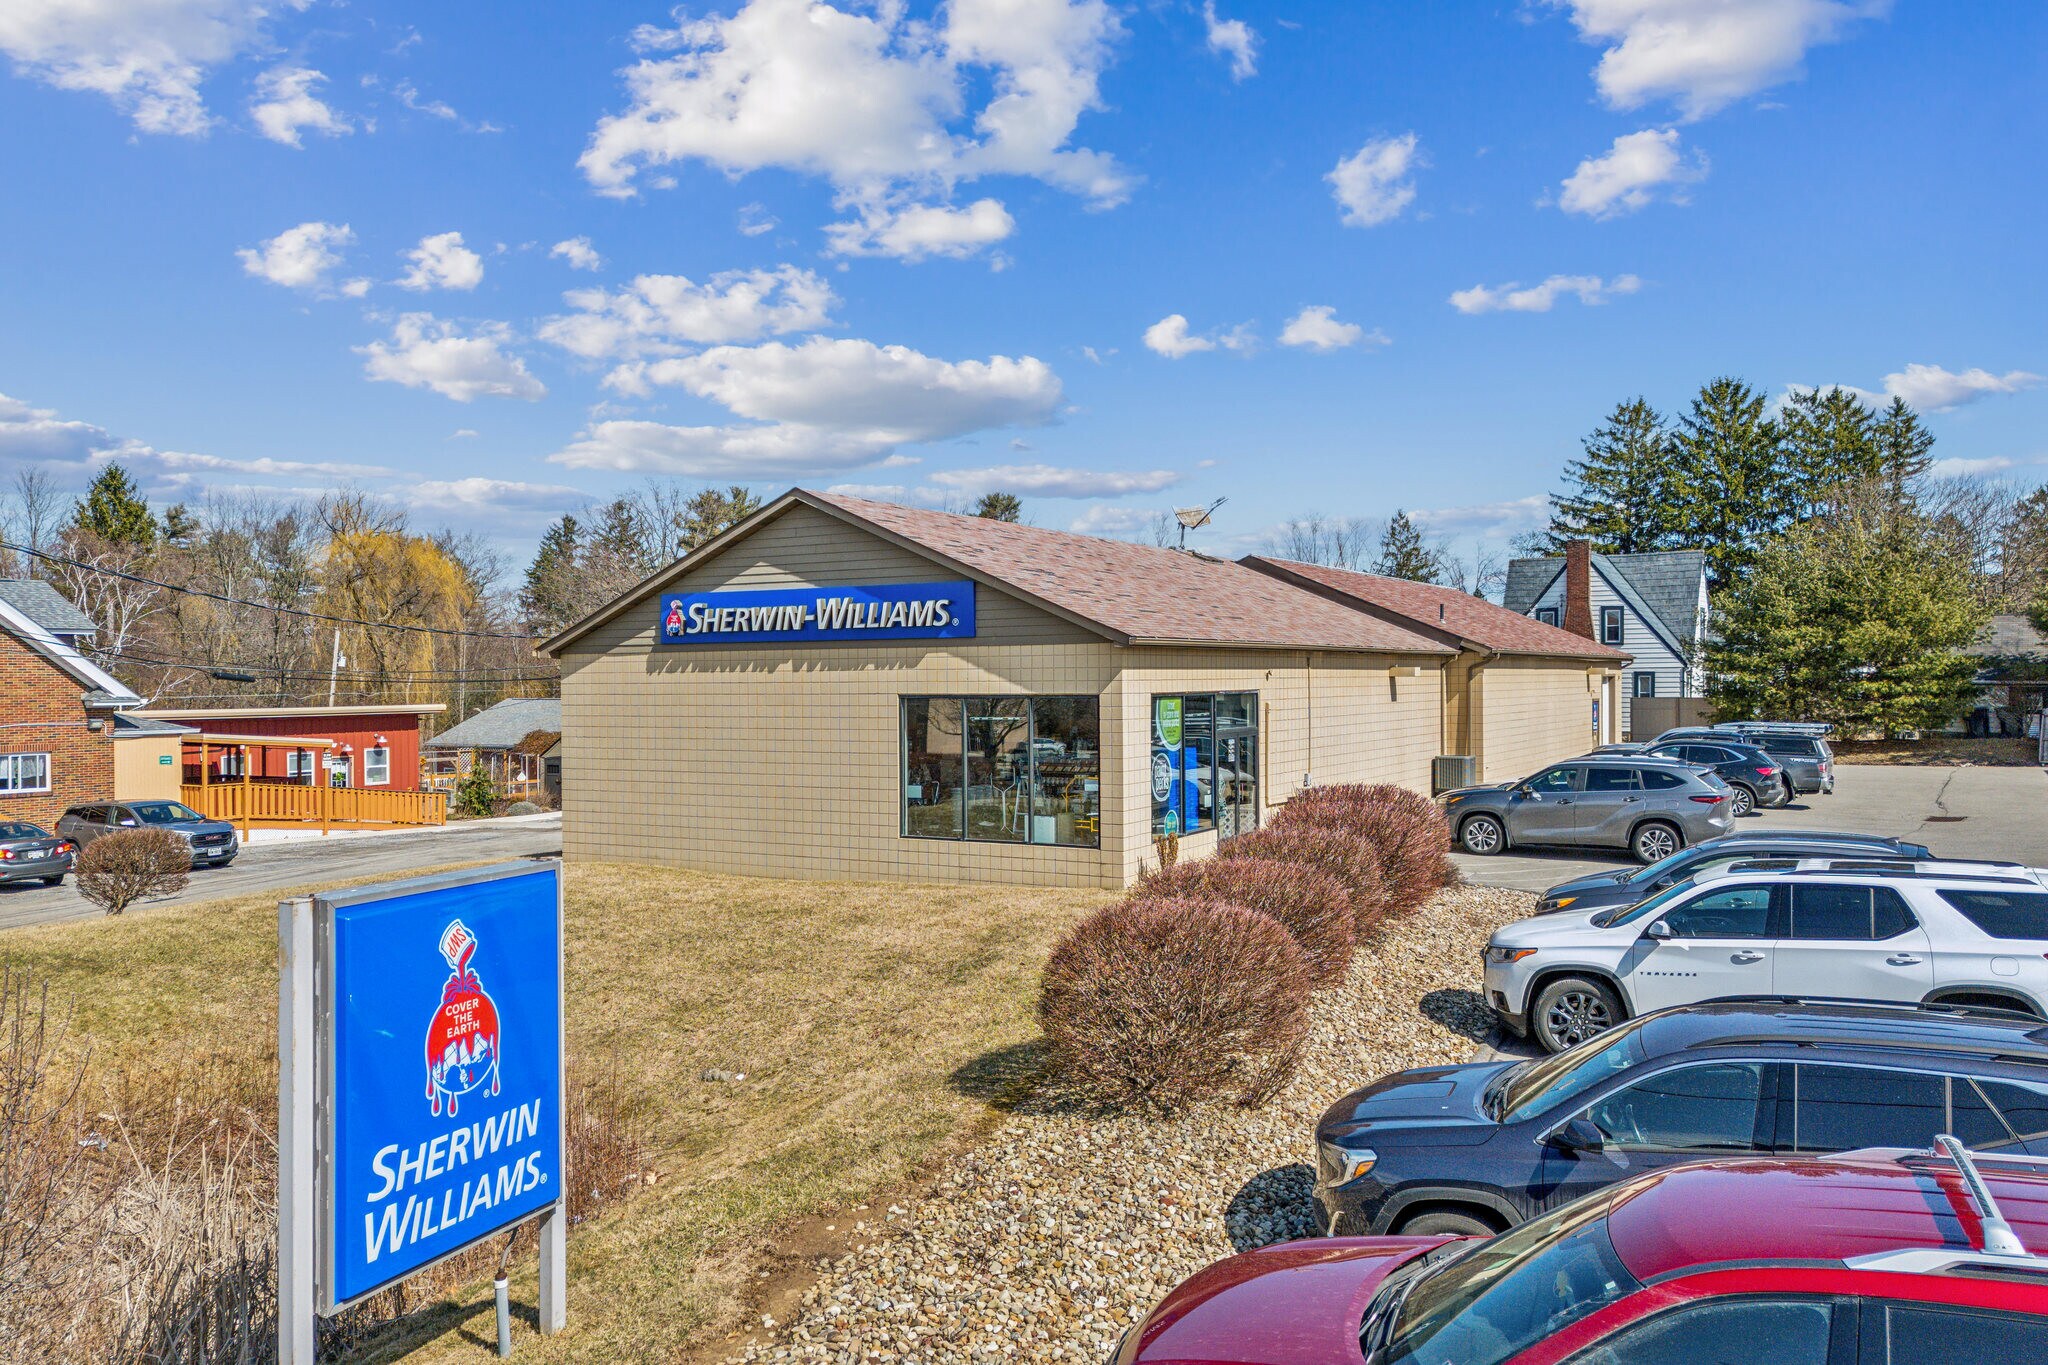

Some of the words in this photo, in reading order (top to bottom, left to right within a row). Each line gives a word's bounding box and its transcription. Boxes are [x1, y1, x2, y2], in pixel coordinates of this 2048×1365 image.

[686, 597, 950, 633] SHERWIN-WILLIAMS
[447, 928, 466, 958] SWP
[446, 998, 479, 1016] COVER
[453, 1011, 473, 1025] THE
[447, 1020, 480, 1038] EARTH
[367, 1098, 541, 1203] SHERWIN
[364, 1150, 541, 1264] WILLIAMS
